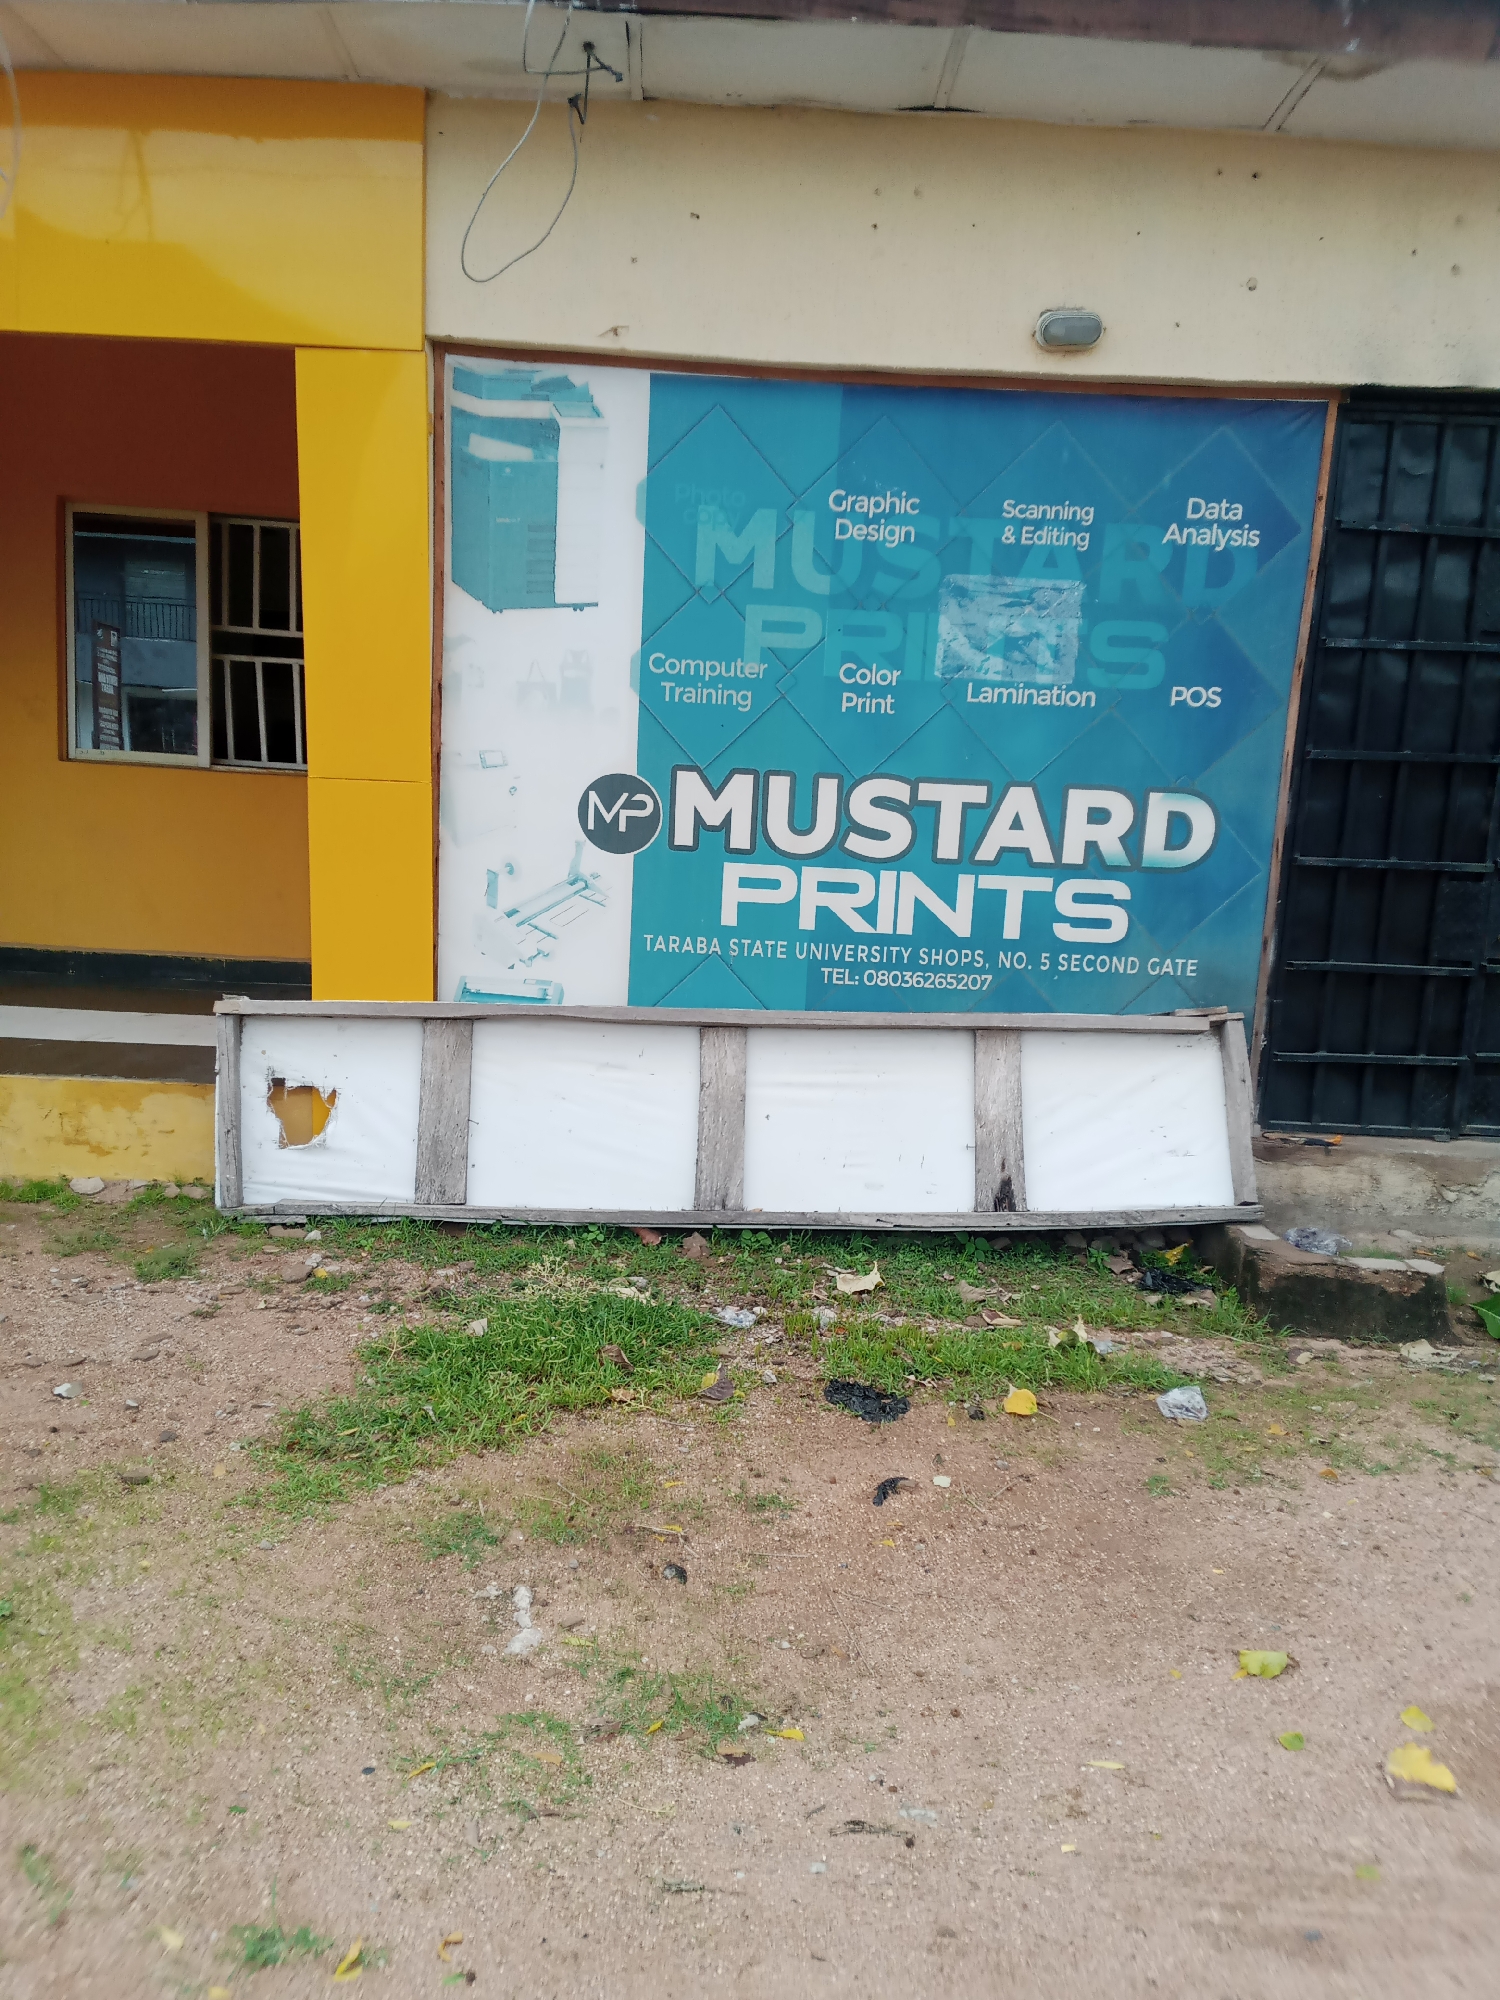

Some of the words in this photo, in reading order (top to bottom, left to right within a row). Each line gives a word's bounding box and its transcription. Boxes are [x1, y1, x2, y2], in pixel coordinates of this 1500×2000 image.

[828, 489, 920, 518] Graphic
[1002, 499, 1095, 526] Scanning
[1186, 497, 1243, 521] Data
[835, 518, 915, 548] Design
[1001, 527, 1016, 545] &
[1020, 526, 1090, 551] Editing
[1162, 523, 1260, 551] Analysis
[743, 604, 1169, 690] PRIS
[648, 652, 768, 681] Computer
[839, 662, 901, 686] Color
[660, 681, 752, 712] Training
[841, 692, 895, 714] Print
[966, 682, 1096, 708] Lamination
[1170, 686, 1222, 708] POS
[669, 764, 1219, 872] MUSTARD
[720, 862, 1132, 943] PRINTS
[643, 934, 722, 956] TARABA
[729, 938, 788, 959] STATE
[795, 942, 912, 965] UNIVERSITY
[918, 947, 989, 971] SHOPS,
[998, 951, 1033, 970] NO.
[1040, 953, 1050, 971] 5
[1057, 953, 1140, 975] SECOND
[1147, 958, 1198, 977] GATE
[821, 967, 859, 986] TEL:
[863, 969, 993, 991] 08036265207
